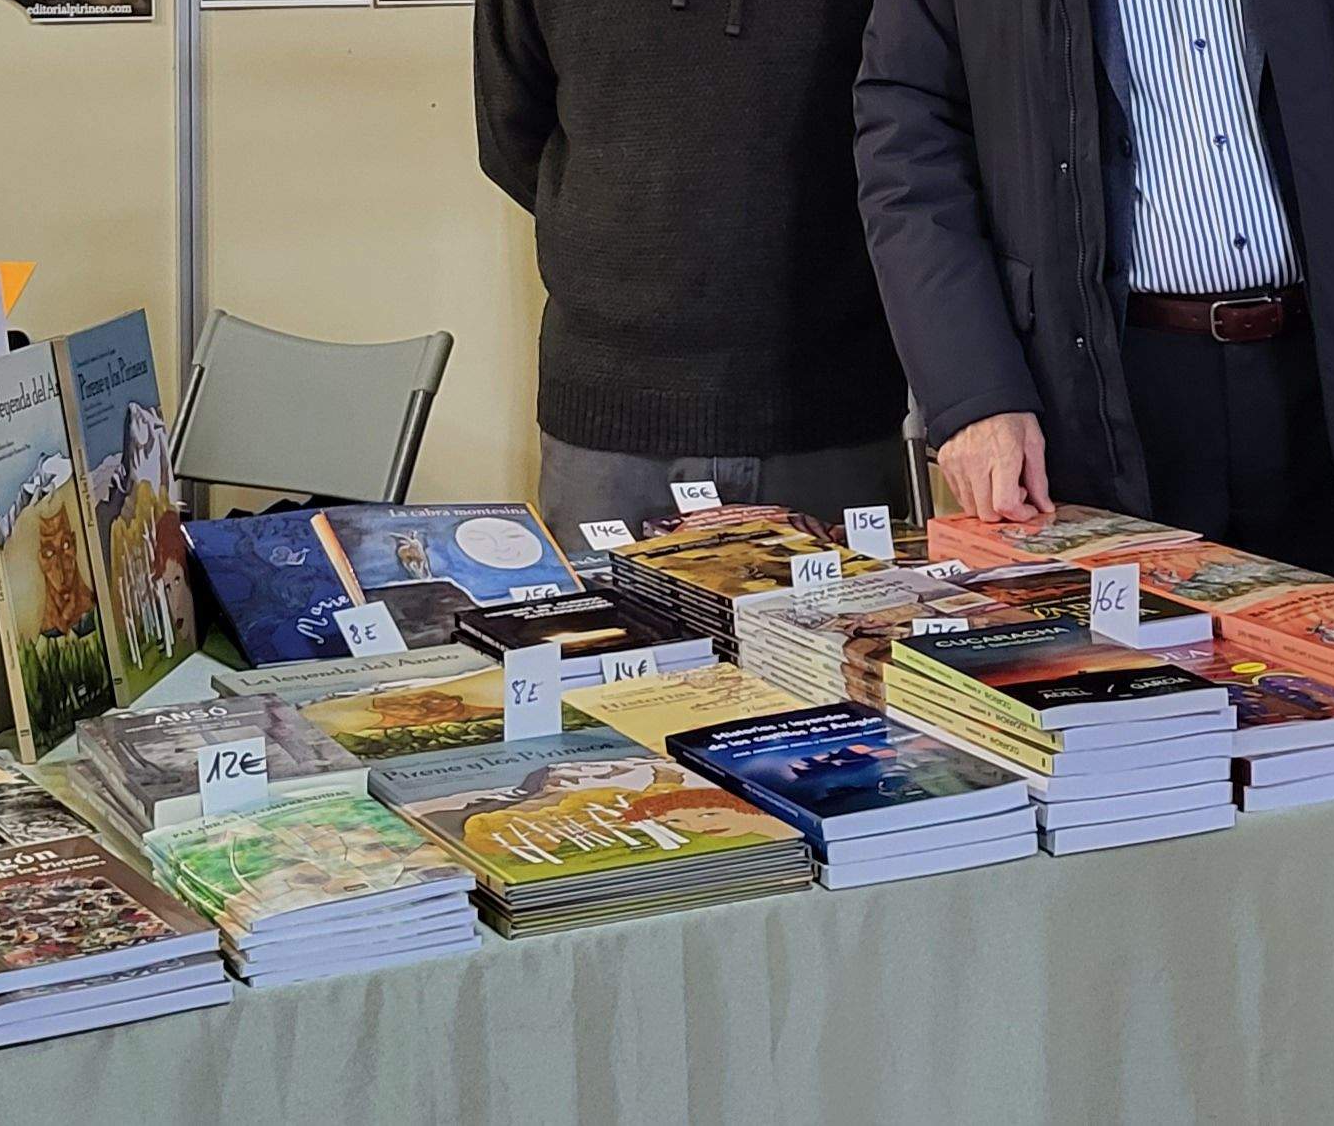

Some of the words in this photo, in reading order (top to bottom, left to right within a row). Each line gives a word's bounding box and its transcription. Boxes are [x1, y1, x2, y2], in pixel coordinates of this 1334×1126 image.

[32, 375, 47, 408] del
[680, 486, 719, 500] 16€
[389, 509, 408, 518] La
[410, 508, 450, 518] cabra
[453, 506, 528, 517] montesina
[852, 512, 886, 531] 15€
[590, 524, 627, 539] 14€
[797, 558, 841, 582] 14€
[1092, 580, 1129, 616] 16€
[935, 626, 1070, 649] CUCARACHA
[239, 676, 271, 687] La
[271, 665, 358, 686] leyenda
[359, 659, 395, 672] del
[398, 654, 460, 667] Aneto
[512, 679, 545, 705] 8€
[155, 704, 229, 725] ANSÓ
[708, 742, 728, 752] de
[729, 736, 751, 747] los
[753, 728, 808, 743] castillos
[811, 726, 829, 735] de
[831, 715, 883, 732] Aragón
[206, 750, 267, 784] 12€
[383, 763, 467, 782] Pirene
[469, 759, 483, 776] y
[484, 754, 518, 771] los
[518, 741, 616, 767] Pirineos
[15, 863, 39, 877] los
[40, 853, 100, 872] Pirineos
